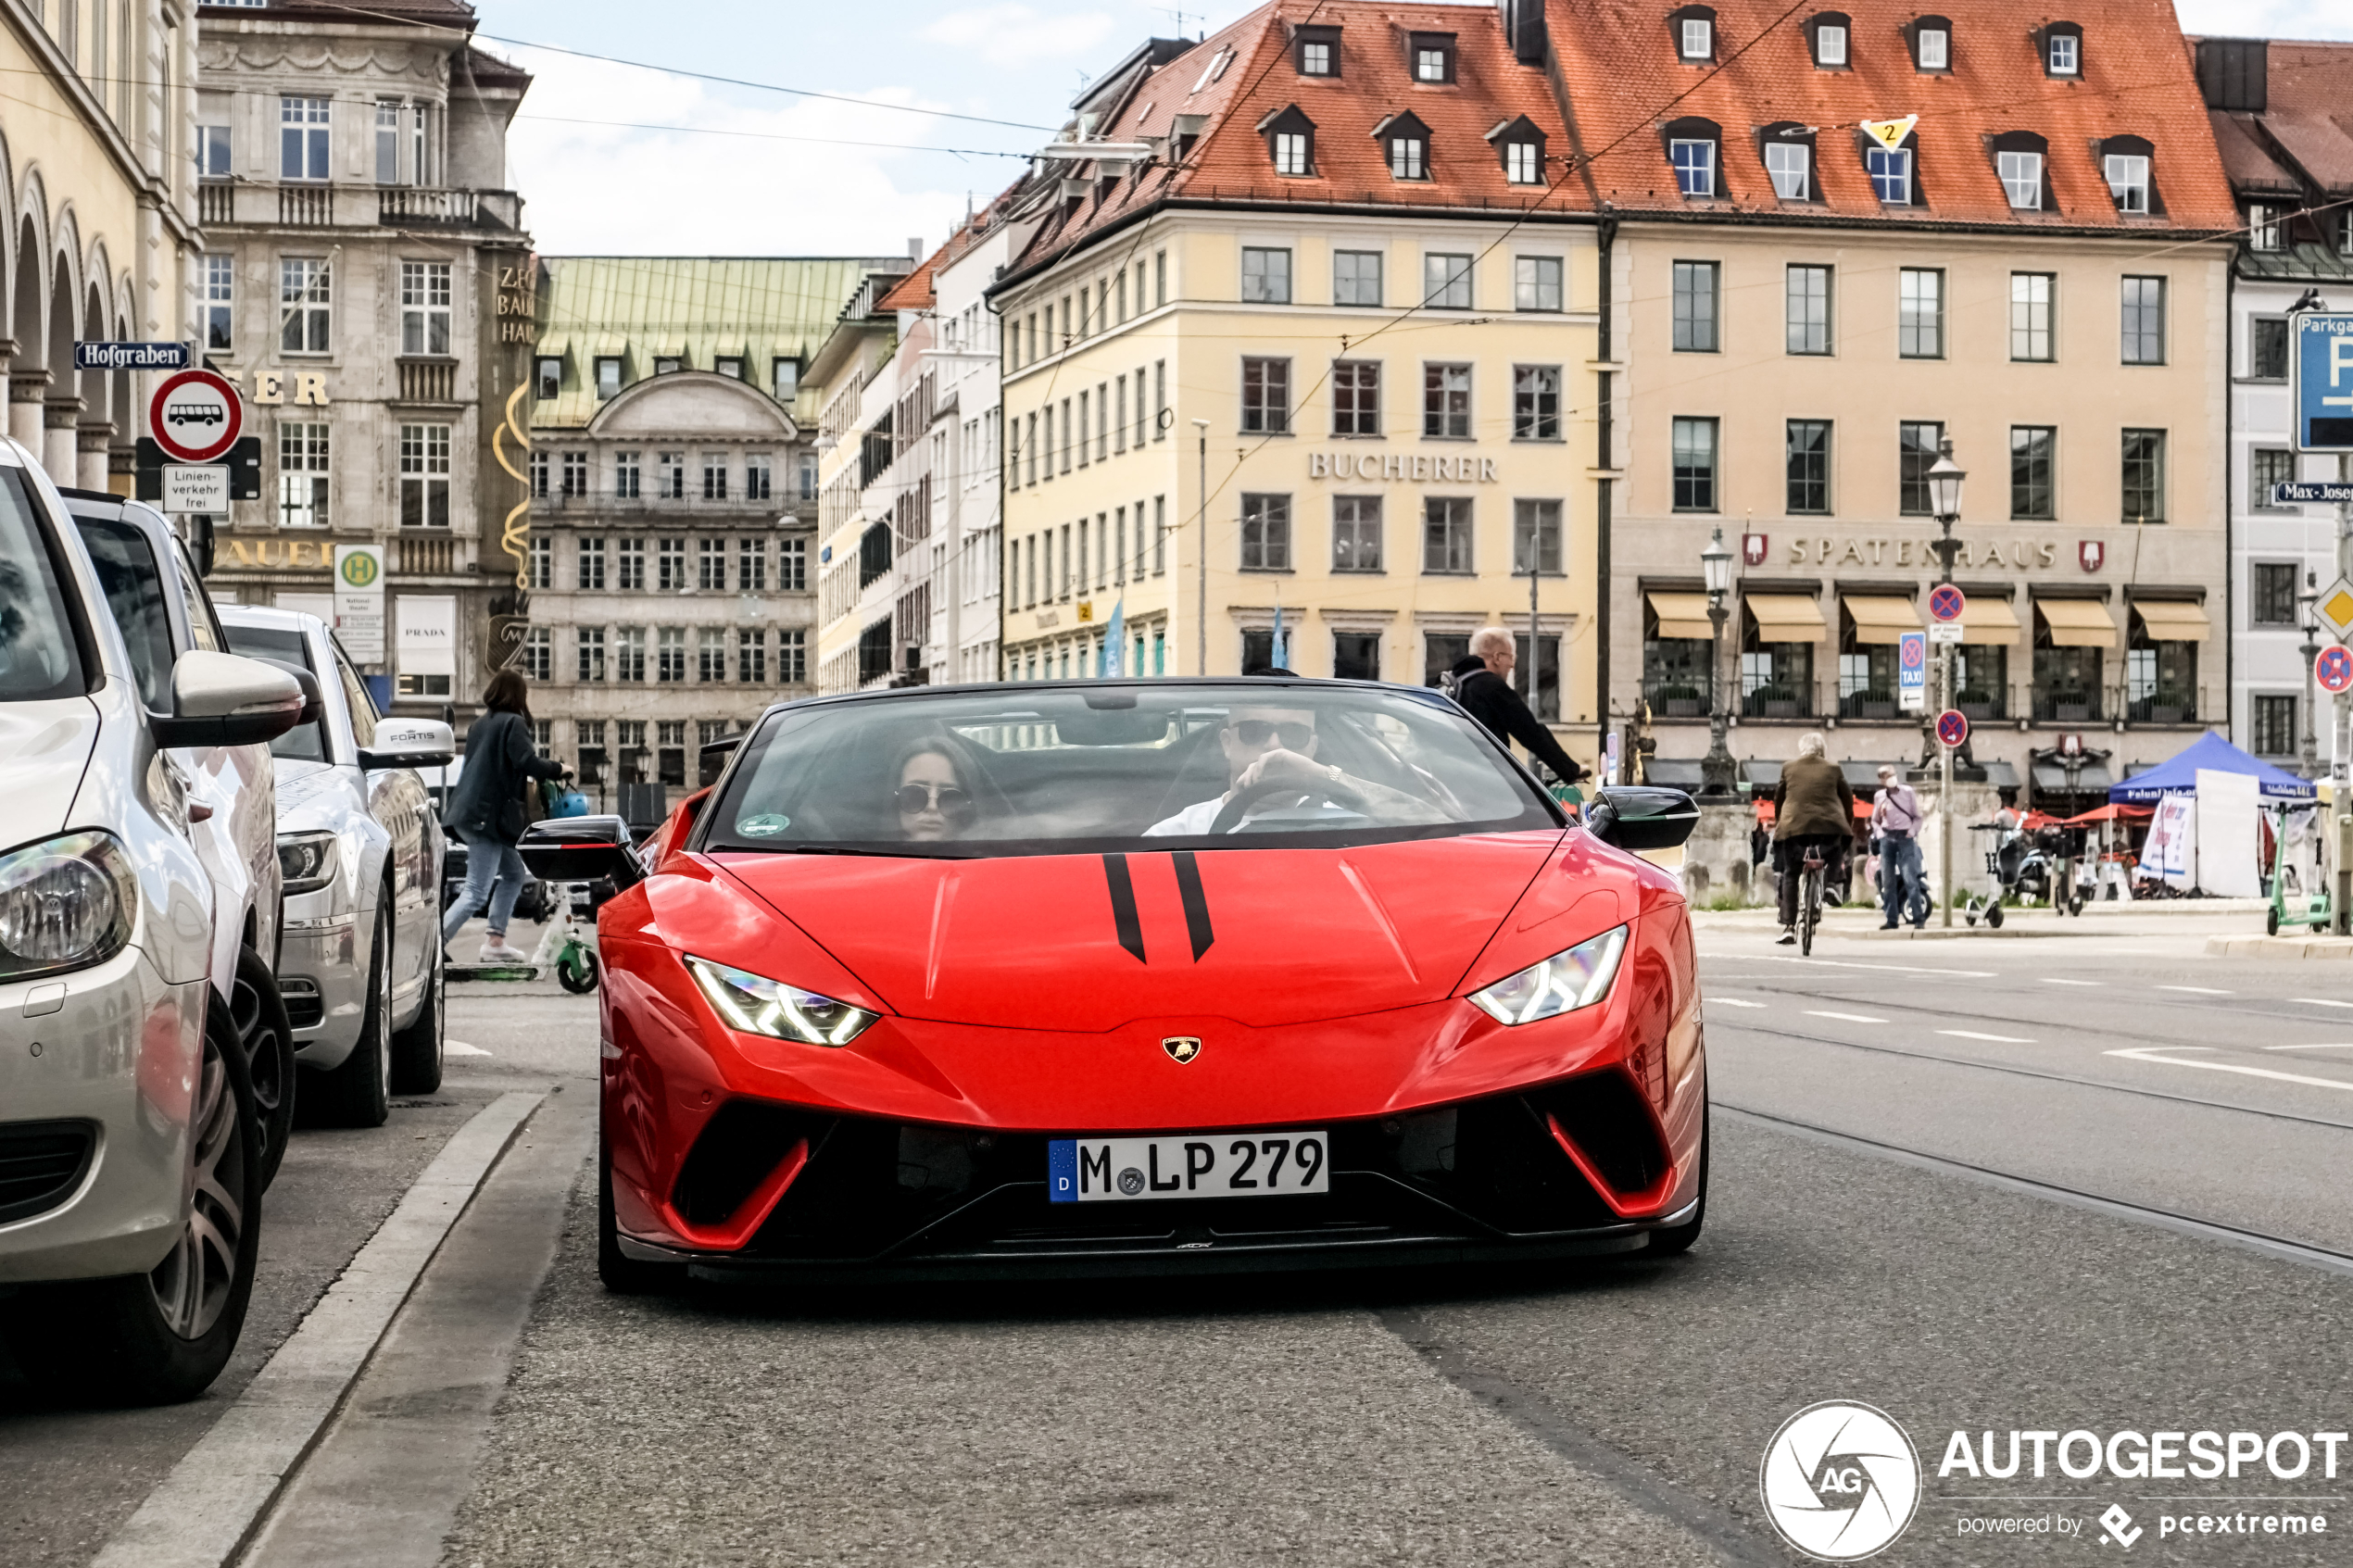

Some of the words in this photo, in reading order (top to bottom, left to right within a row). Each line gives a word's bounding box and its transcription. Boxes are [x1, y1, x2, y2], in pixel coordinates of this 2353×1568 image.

[1884, 124, 1896, 141] 2
[84, 344, 180, 368] Hofgraben
[1309, 452, 1499, 483] BUCHERER
[174, 470, 217, 482] Linien-
[172, 484, 220, 495] verkehr
[185, 498, 207, 508] frei
[1789, 538, 2057, 568] SPATENHAUS
[1080, 608, 1089, 619] 2
[406, 629, 446, 637] PRADA
[1902, 670, 1922, 684] TAXI
[390, 732, 435, 742] FORTIS
[1058, 1177, 1069, 1191] D
[1079, 1145, 1112, 1194] M
[1149, 1142, 1215, 1191] LP
[1229, 1138, 1324, 1189] 279
